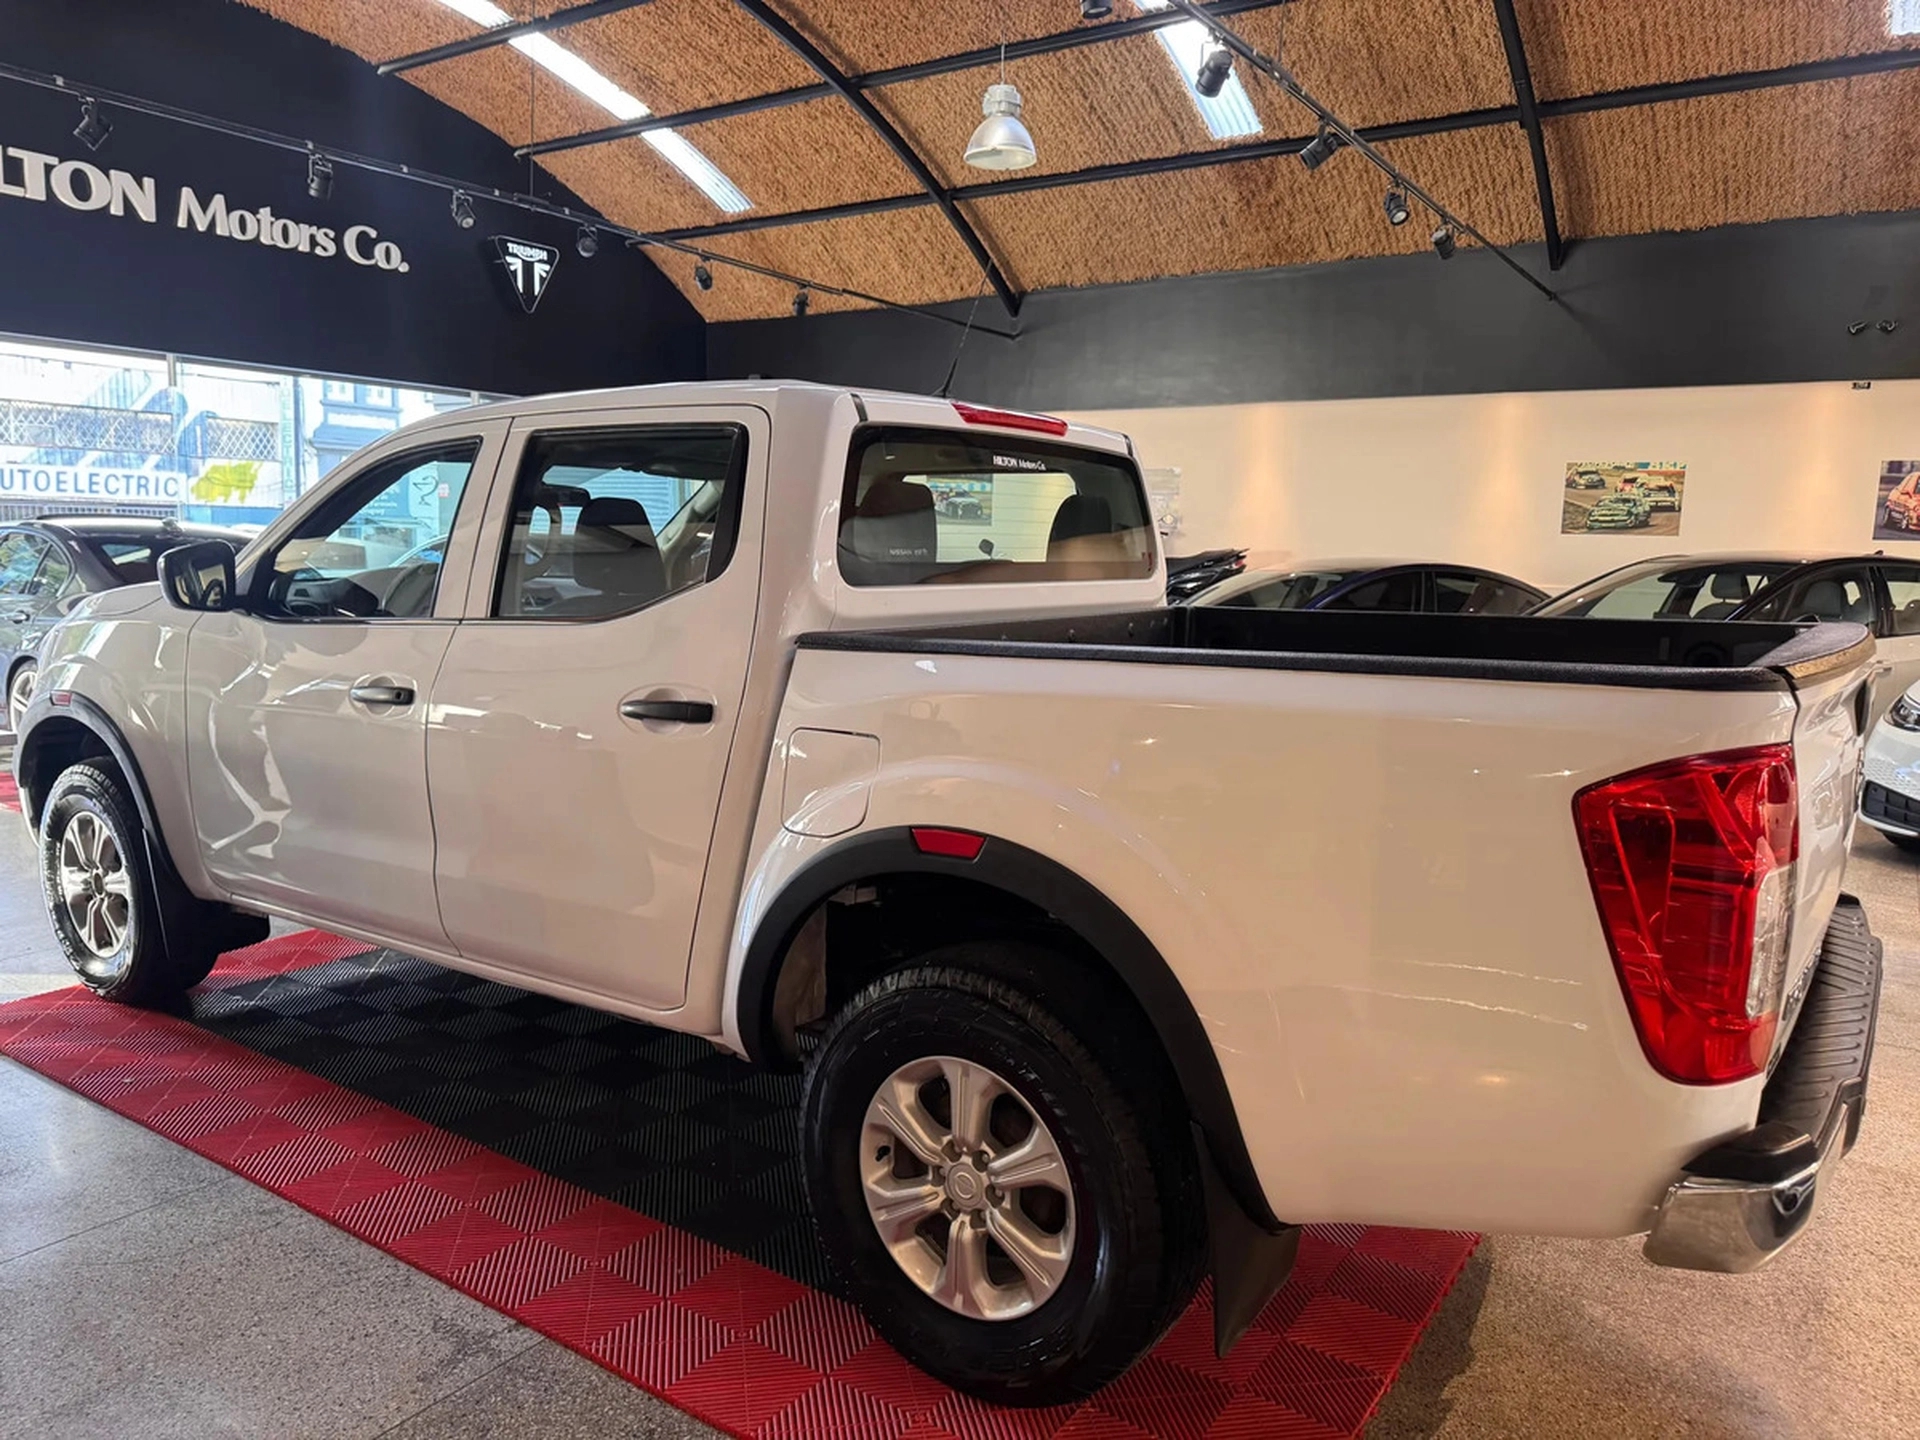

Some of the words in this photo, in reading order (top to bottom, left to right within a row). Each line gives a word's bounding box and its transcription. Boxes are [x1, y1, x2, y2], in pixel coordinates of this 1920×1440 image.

[177, 186, 336, 257] Motors
[343, 225, 410, 273] Co.
[507, 242, 548, 261] TRIUMPH
